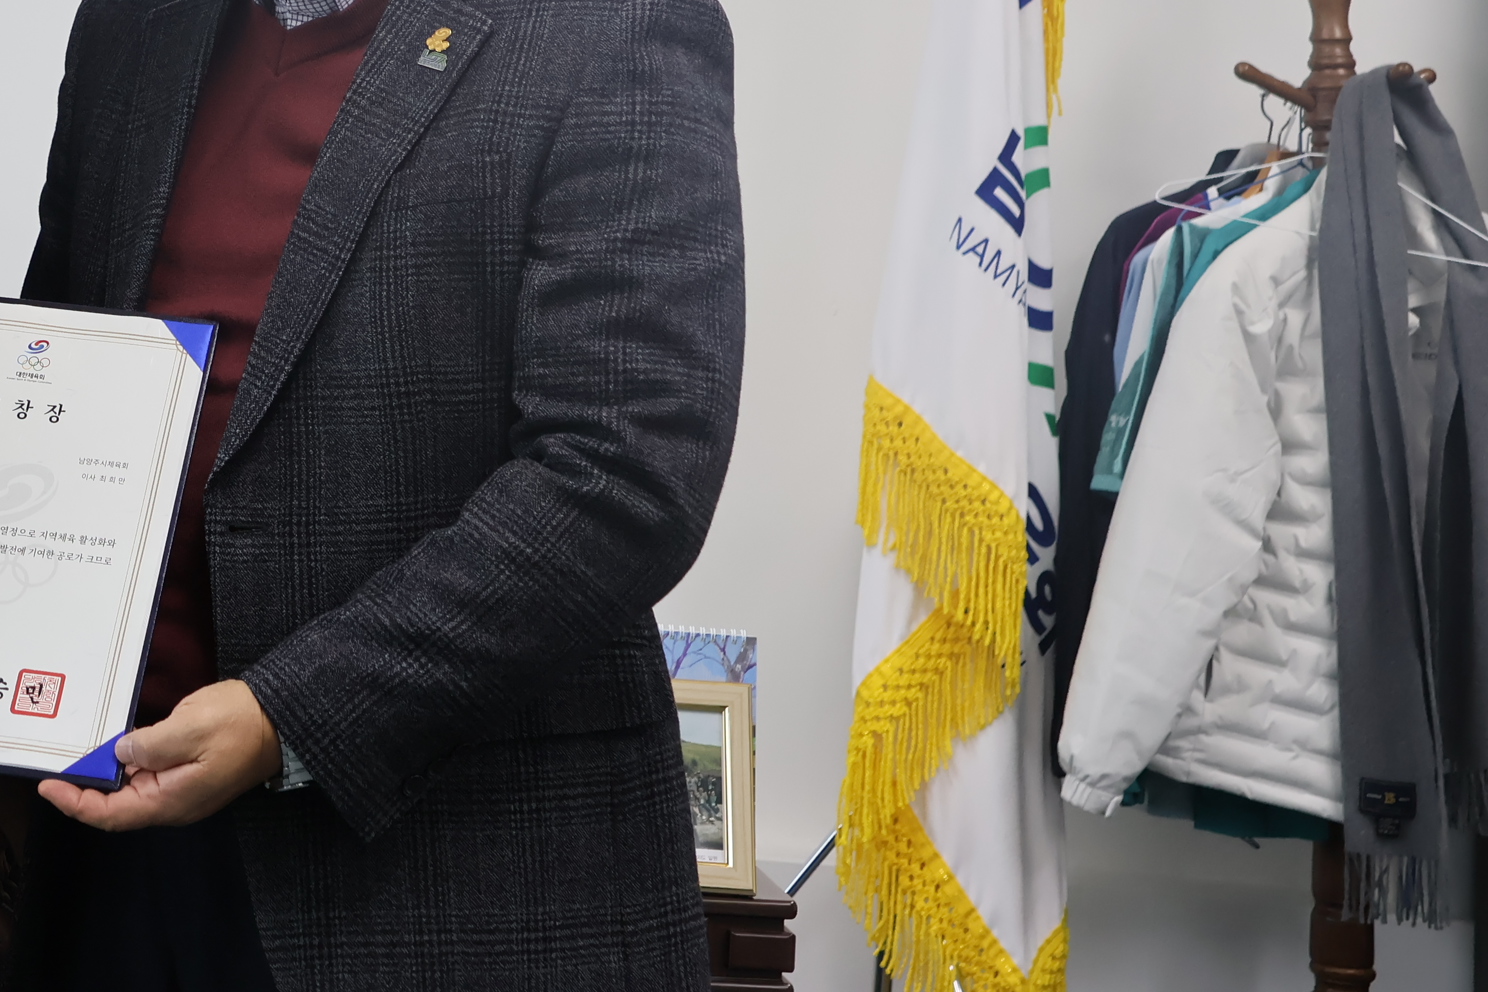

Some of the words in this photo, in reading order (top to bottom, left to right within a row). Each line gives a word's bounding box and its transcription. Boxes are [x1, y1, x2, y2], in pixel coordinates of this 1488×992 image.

[78, 457, 129, 470] 남양주시체육회
[0, 526, 36, 538] 열정으로
[39, 530, 76, 544] 지역체육
[78, 535, 116, 548] 활성화와
[28, 547, 55, 560] 기여한
[57, 551, 83, 563] 공로가
[85, 555, 112, 566] 크므로
